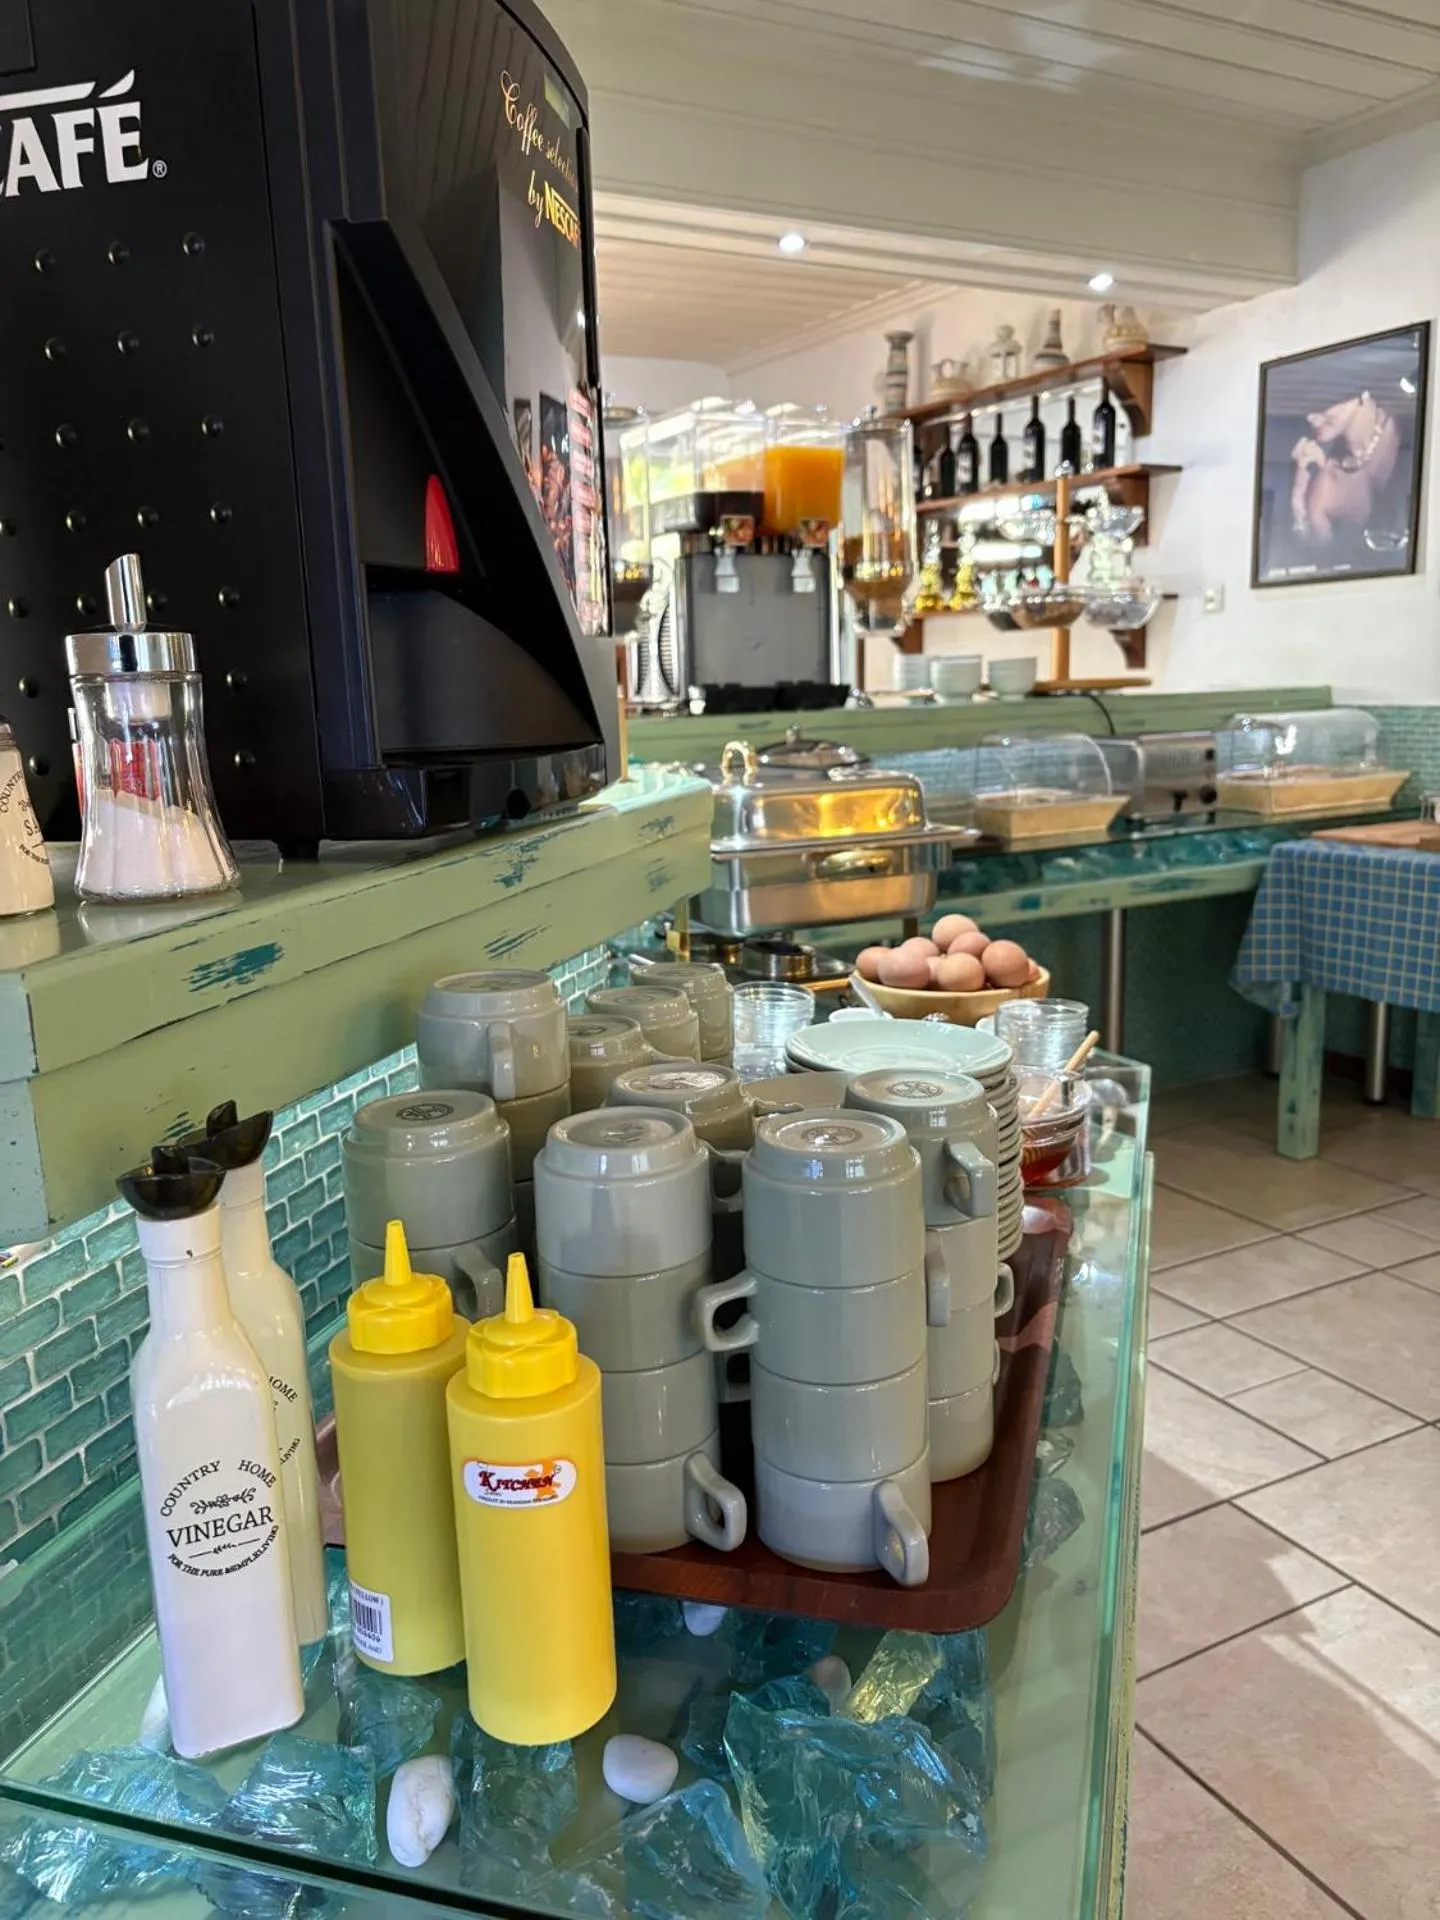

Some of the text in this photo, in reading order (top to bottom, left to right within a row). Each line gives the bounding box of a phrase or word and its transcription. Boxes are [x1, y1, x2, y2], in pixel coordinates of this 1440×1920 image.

[0, 69, 149, 197] AFÉ
[501, 70, 544, 156] Coffee
[528, 169, 544, 228] by
[160, 1459, 276, 1517] COUNTRY HOME
[166, 1506, 274, 1548] VINEGAR
[180, 1563, 200, 1576] THE
[200, 1567, 224, 1577] PURE
